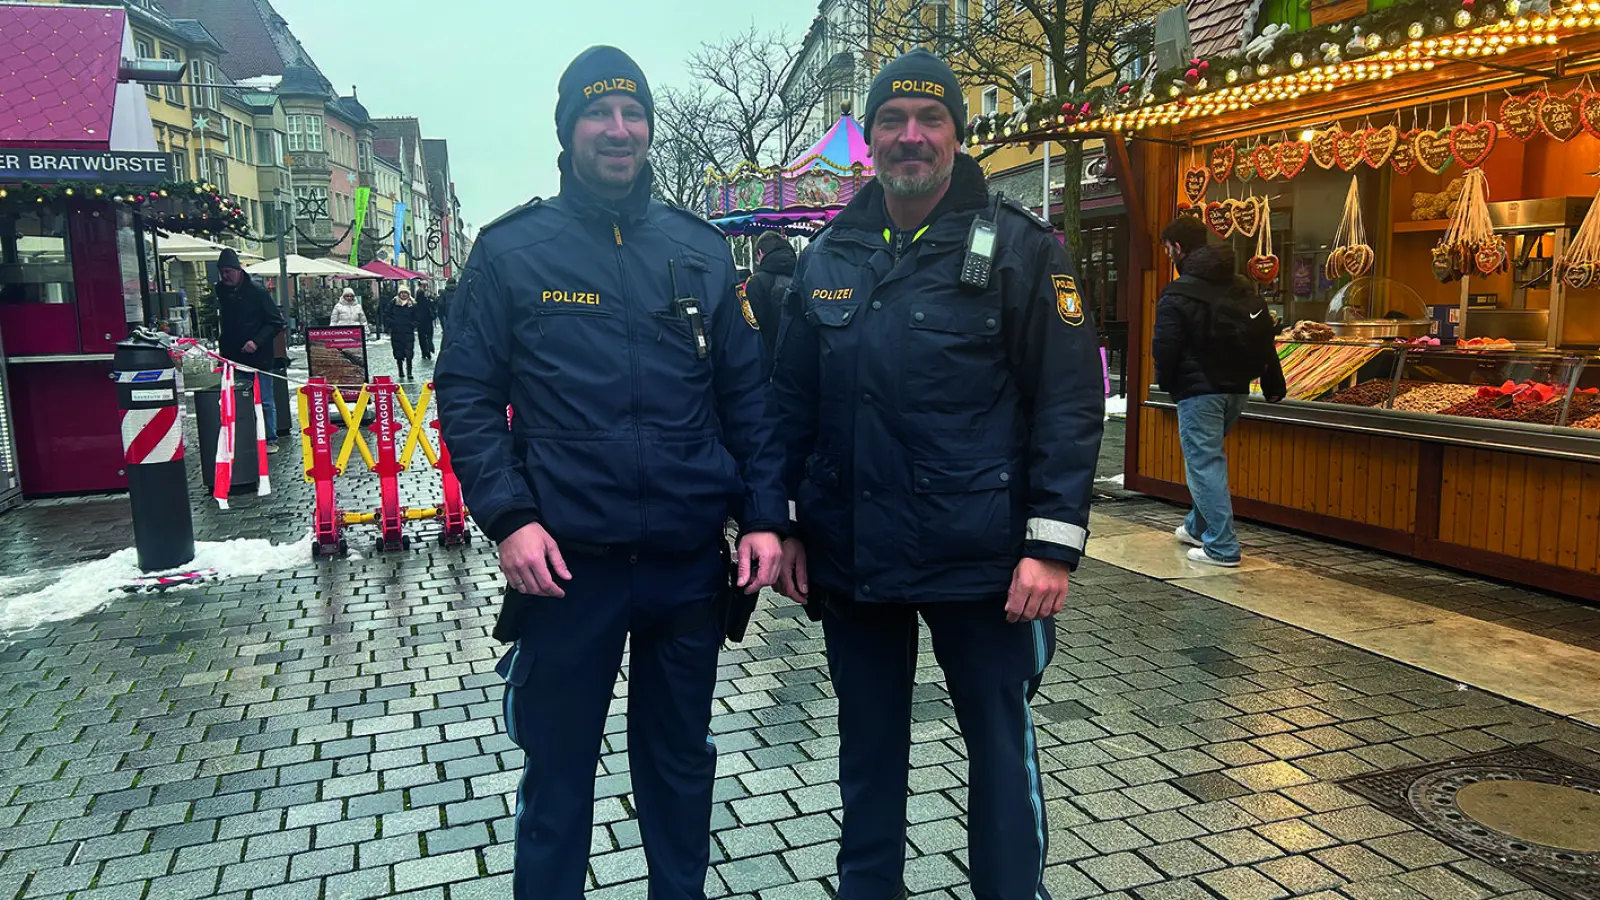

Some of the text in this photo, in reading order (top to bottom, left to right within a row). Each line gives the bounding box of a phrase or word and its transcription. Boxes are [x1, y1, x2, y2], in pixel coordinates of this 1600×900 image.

[583, 77, 637, 100] POLIZEI
[892, 79, 945, 98] POLIZEI
[29, 153, 167, 173] BRATWÜRSTE
[542, 290, 600, 305] POLIZEI
[811, 288, 854, 300] POLIZEI
[314, 390, 327, 445] PITAGONE
[378, 388, 391, 442] PITAGONE
